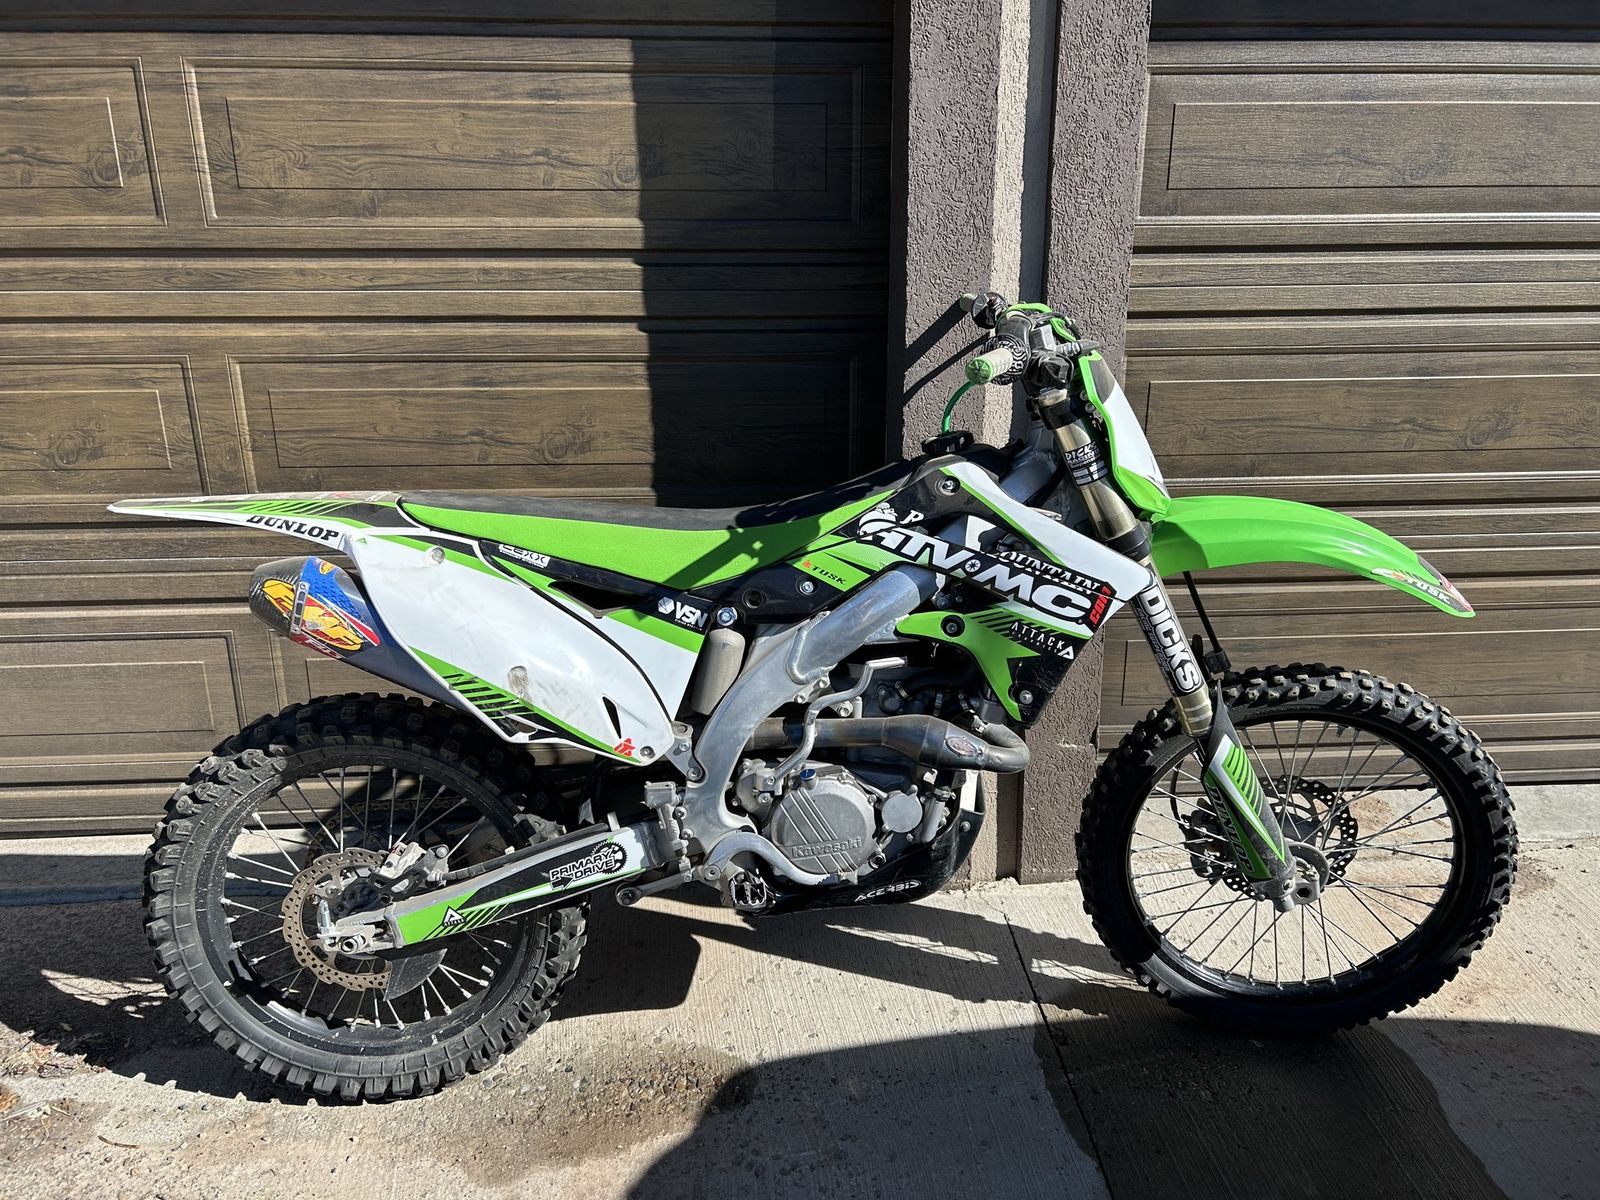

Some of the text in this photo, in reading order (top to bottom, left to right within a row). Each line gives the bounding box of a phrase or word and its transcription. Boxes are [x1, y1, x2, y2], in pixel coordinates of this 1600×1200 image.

[246, 515, 339, 541] DUNLOP
[812, 565, 846, 585] TUSK
[1011, 621, 1066, 650] ATTACK
[1139, 584, 1200, 690] DICKS
[791, 836, 863, 858] Kawasaki
[551, 848, 613, 880] PRIMARY
[574, 858, 615, 880] DRIVE
